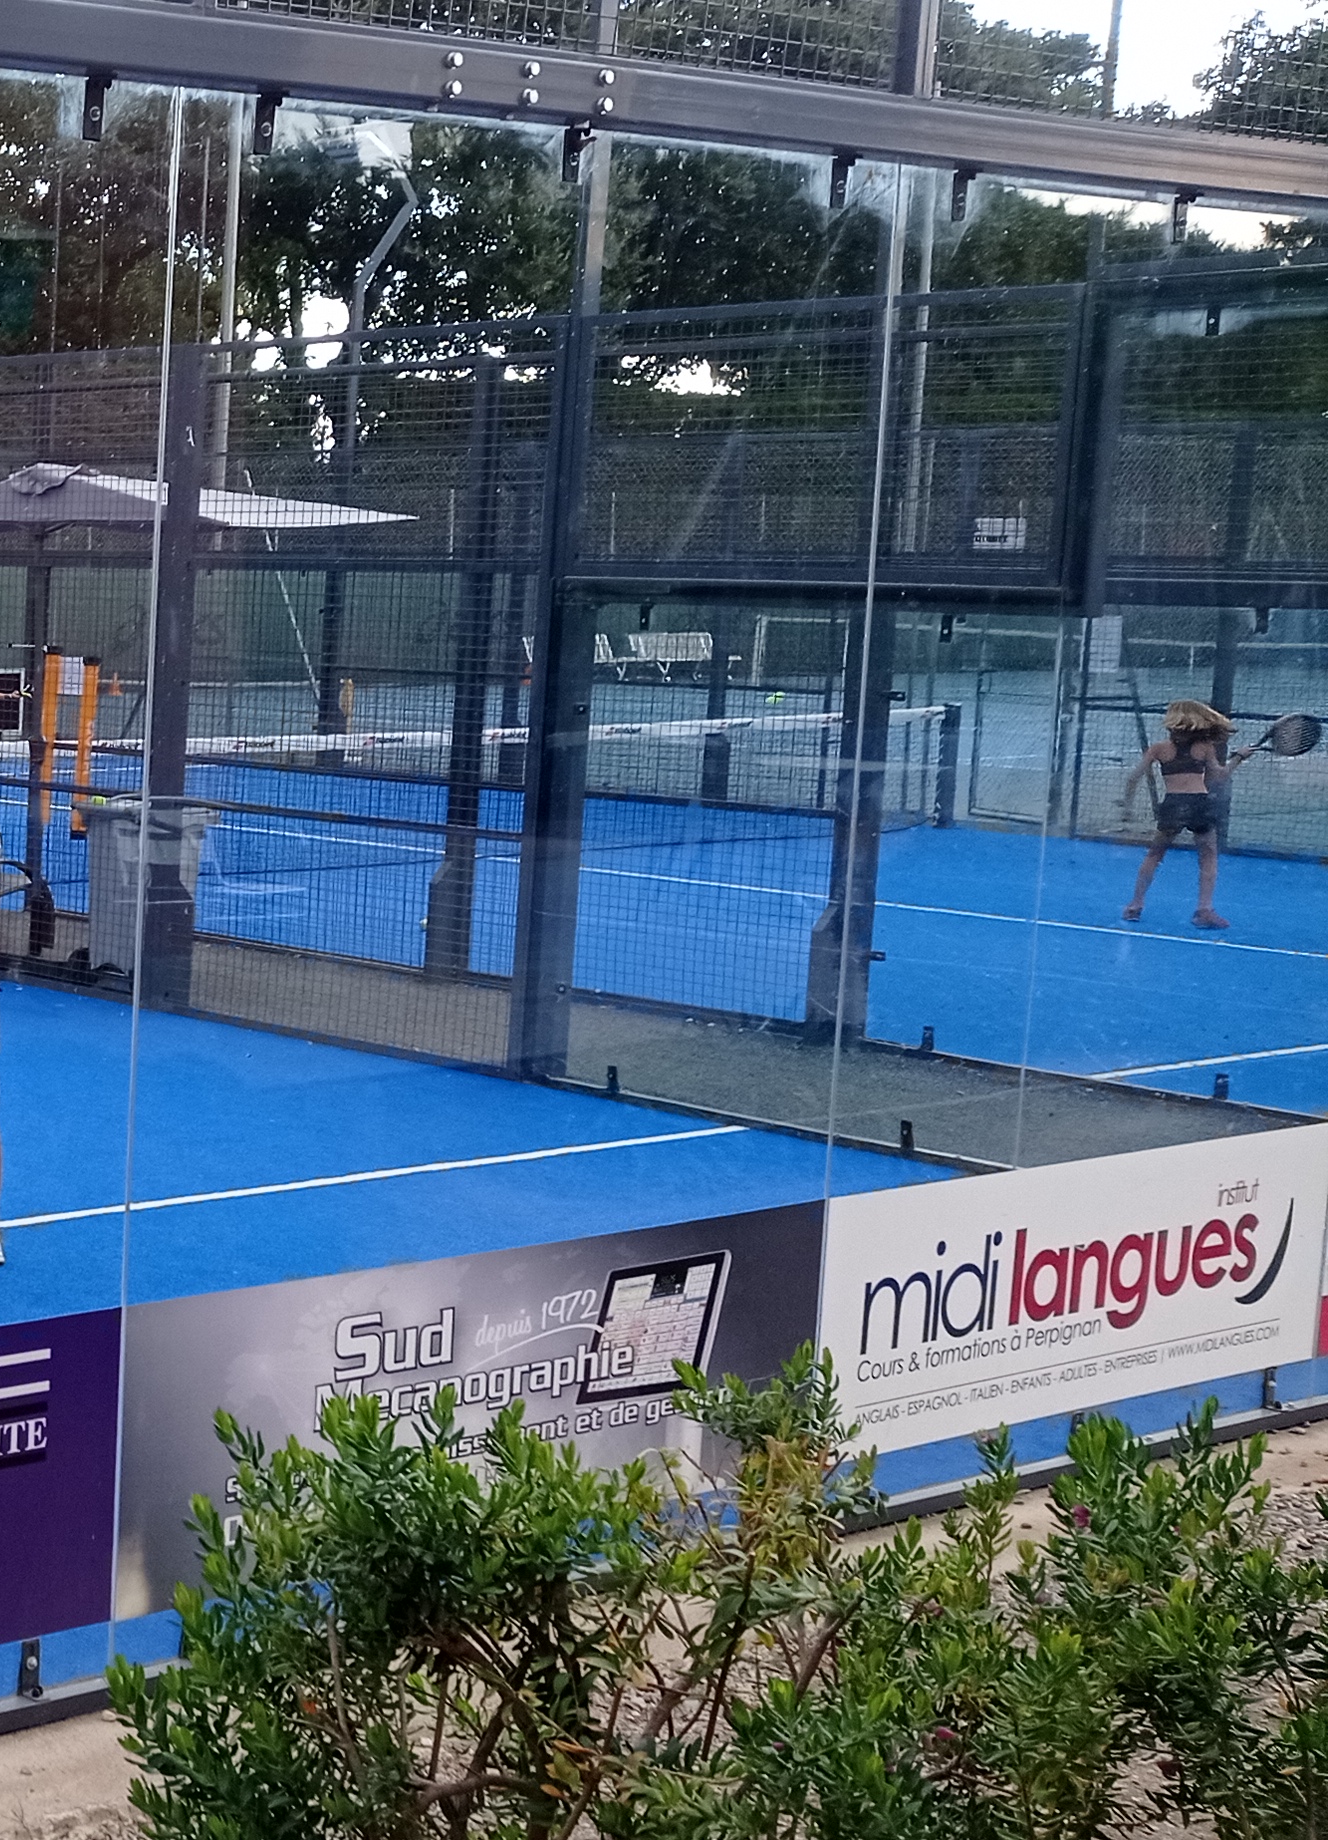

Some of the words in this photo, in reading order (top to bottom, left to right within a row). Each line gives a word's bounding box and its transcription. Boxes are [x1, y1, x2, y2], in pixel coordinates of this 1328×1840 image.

[1217, 1178, 1260, 1207] institut
[860, 1231, 1003, 1355] midi
[1008, 1213, 1259, 1329] langues
[334, 1306, 455, 1382] Sud
[475, 1309, 532, 1351] depuis
[541, 1289, 600, 1330] 1972
[857, 1357, 904, 1382] Cours
[908, 1351, 921, 1372] &
[925, 1336, 1007, 1368] formations
[1010, 1330, 1022, 1351] à
[1025, 1318, 1102, 1349] Perpignan
[575, 1408, 603, 1433] et
[609, 1400, 638, 1427] de
[854, 1406, 900, 1426] ANGLAIS
[907, 1393, 963, 1416] ESPAGNOL
[969, 1383, 1004, 1403] ITALIEN
[1011, 1372, 1052, 1394] ENFANTS
[1059, 1363, 1097, 1383] ADULTES
[1104, 1350, 1158, 1374] ENTREPRISES
